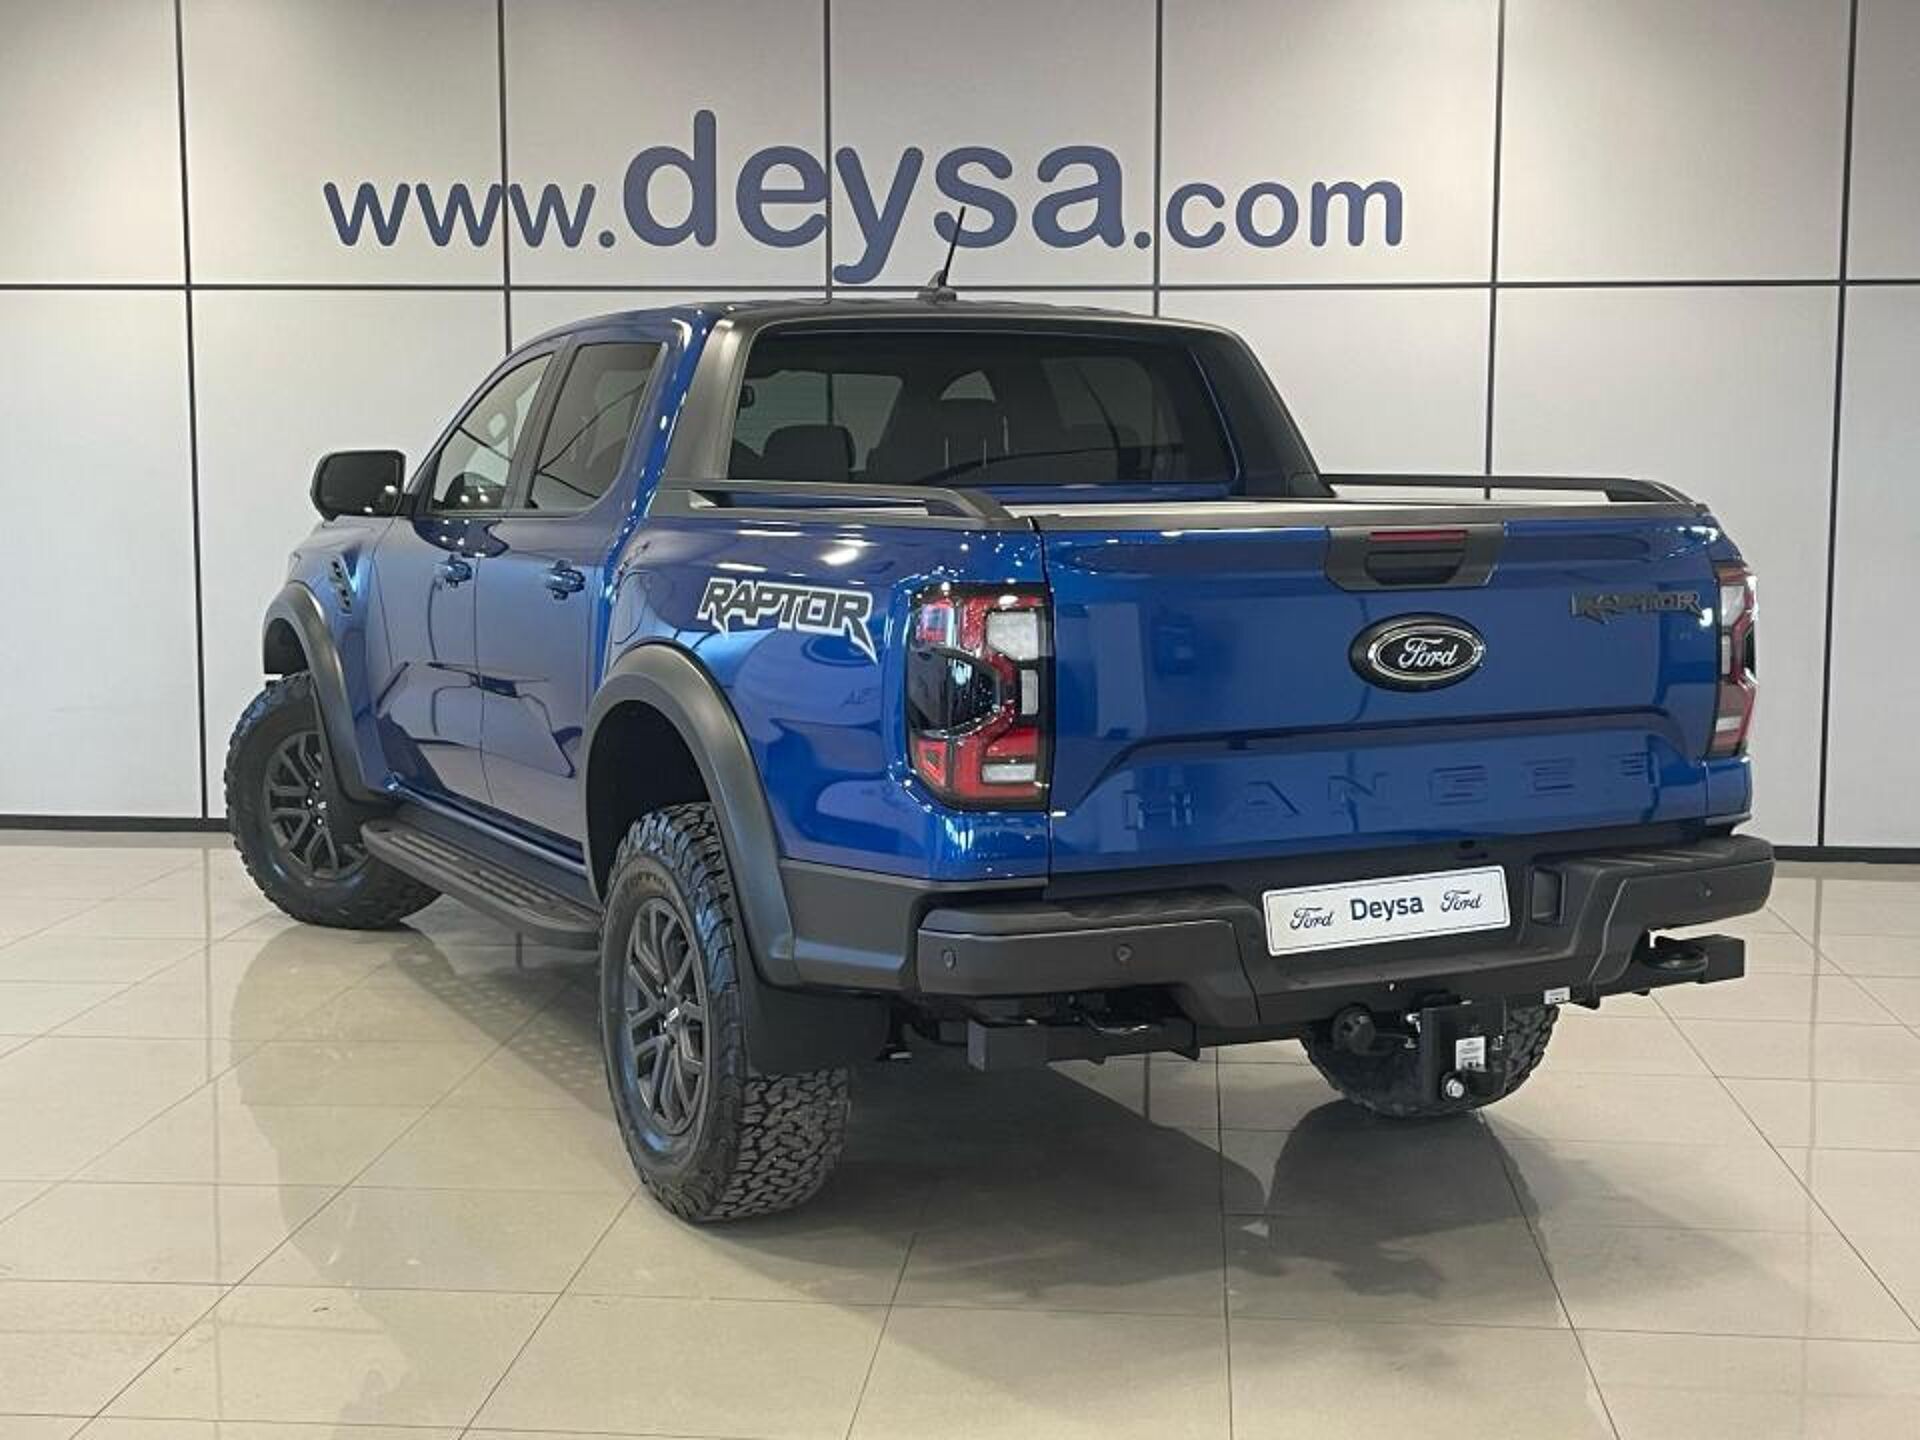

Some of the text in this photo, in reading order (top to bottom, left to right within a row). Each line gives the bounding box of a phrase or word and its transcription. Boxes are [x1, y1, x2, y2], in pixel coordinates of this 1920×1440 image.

[323, 109, 1404, 284] www.deysa.com
[697, 576, 879, 666] RAPTOR
[1398, 637, 1459, 668] Ford
[1289, 889, 1483, 931] Ford Deysa Ford
